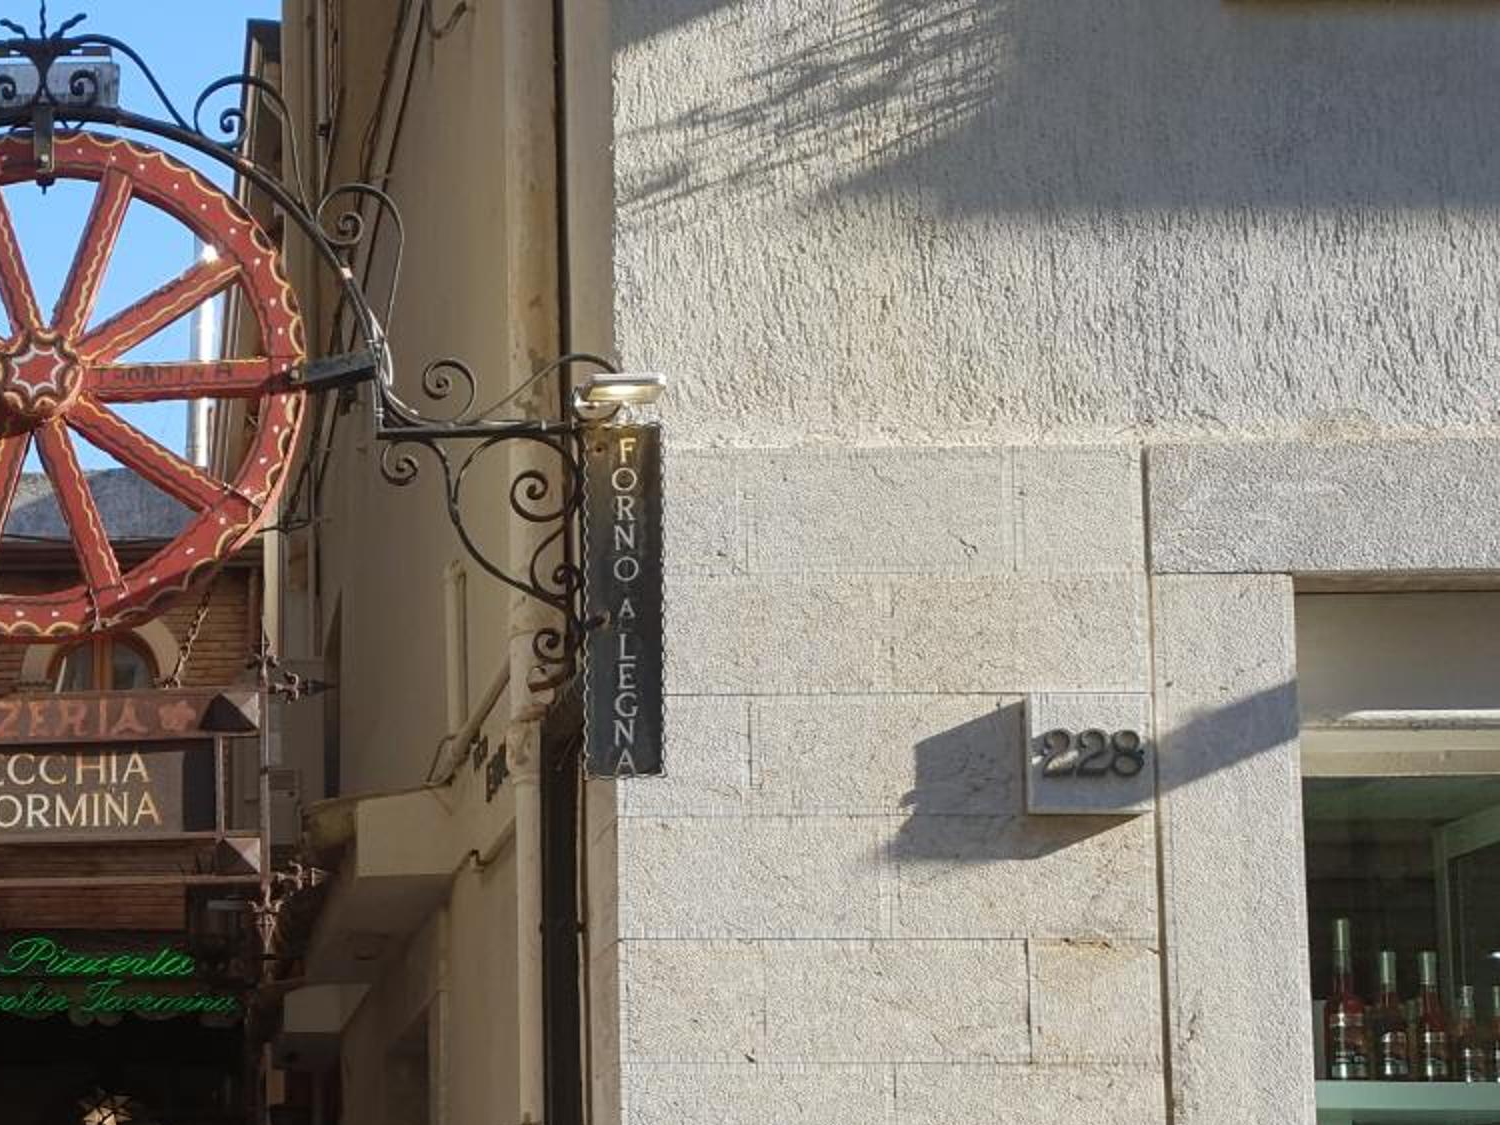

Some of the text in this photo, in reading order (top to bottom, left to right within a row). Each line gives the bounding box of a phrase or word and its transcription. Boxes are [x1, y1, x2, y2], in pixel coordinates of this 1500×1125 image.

[611, 437, 640, 777] FORNO A LEGNA
[1043, 729, 1145, 777] 228
[1, 936, 196, 976] Pizzeria
[81, 979, 238, 1012] Taormina
